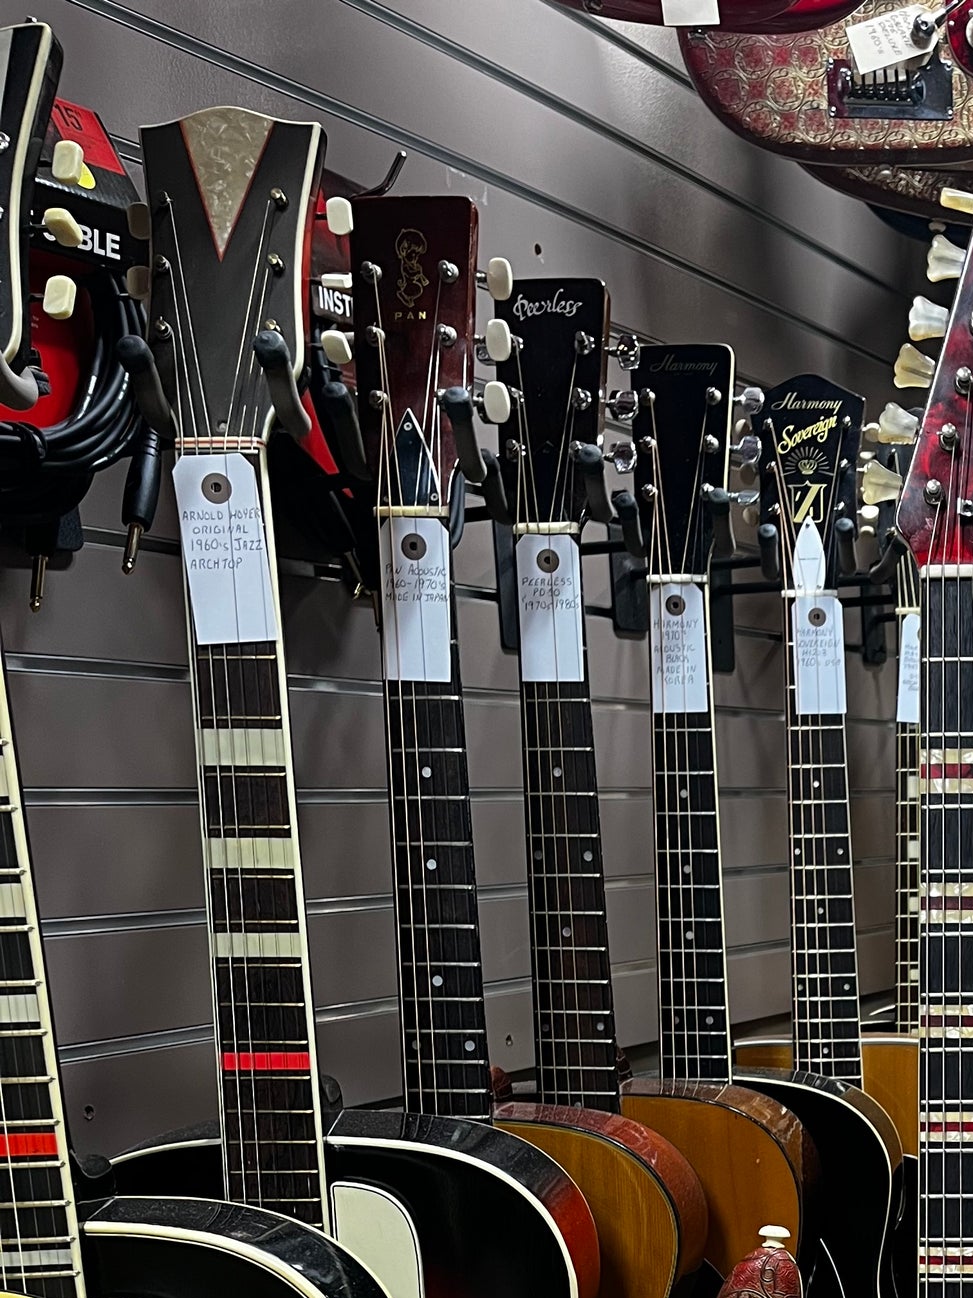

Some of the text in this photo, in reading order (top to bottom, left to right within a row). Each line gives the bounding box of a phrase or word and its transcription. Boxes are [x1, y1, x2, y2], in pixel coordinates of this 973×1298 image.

[512, 288, 583, 321] Peerless
[394, 311, 427, 320] PAN
[649, 353, 719, 377] Harmony
[771, 391, 843, 415] Harmony
[777, 415, 838, 455] Sovereign
[182, 507, 261, 521] ARNOLD HOYER
[192, 524, 249, 535] ORIGINAL
[191, 537, 263, 552] 1960's JAZZ
[521, 576, 573, 587] PEERLESS
[385, 591, 409, 602] MDE
[654, 643, 696, 654] AOUSTIC
[796, 639, 842, 649] OVEREIGN
